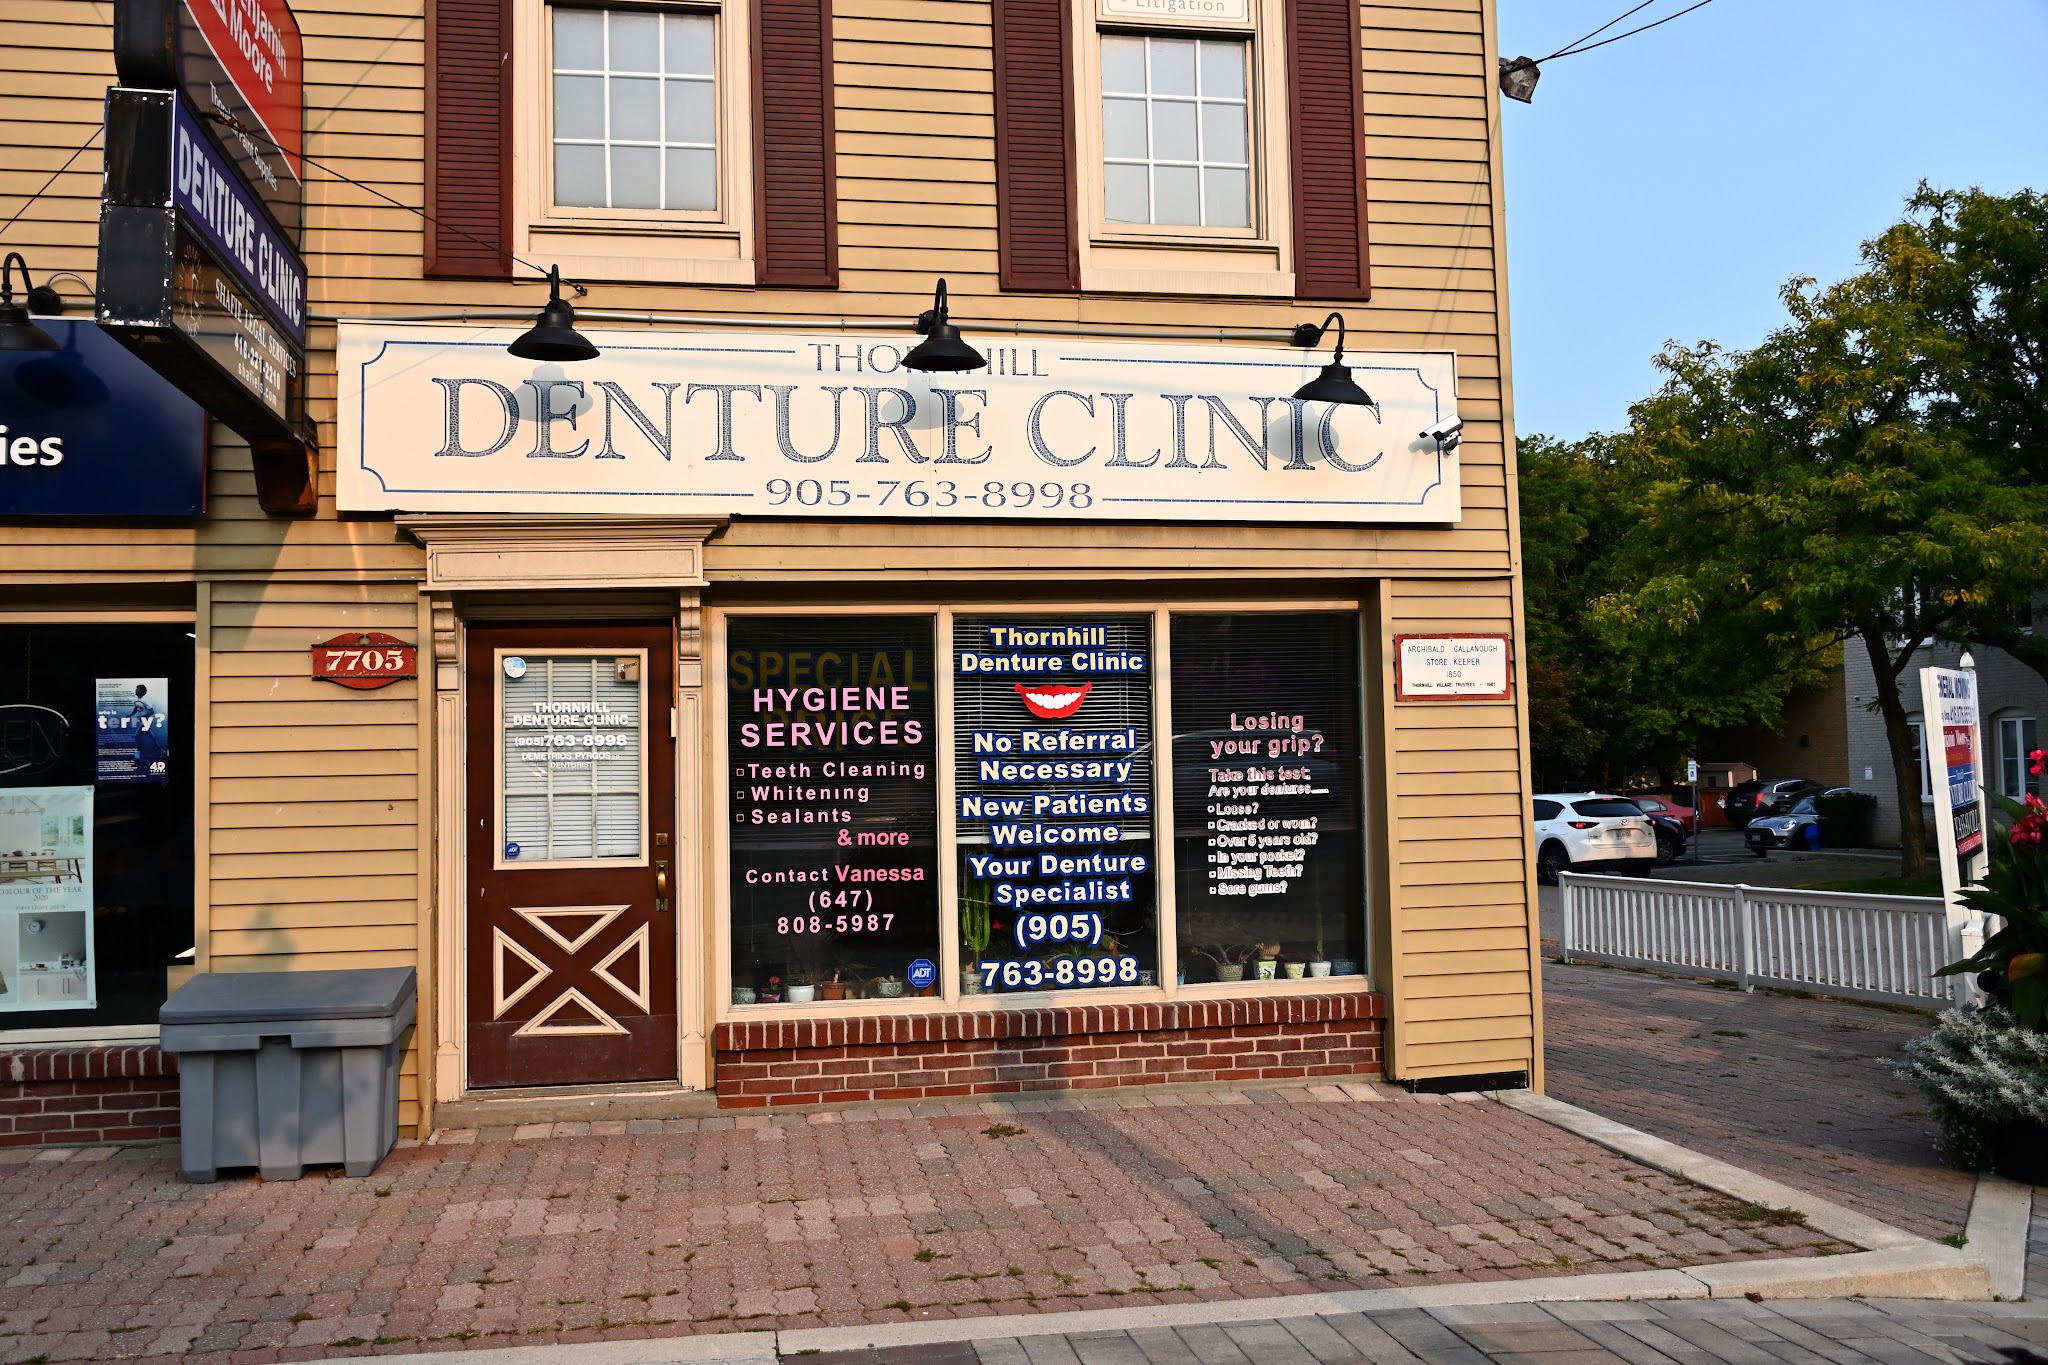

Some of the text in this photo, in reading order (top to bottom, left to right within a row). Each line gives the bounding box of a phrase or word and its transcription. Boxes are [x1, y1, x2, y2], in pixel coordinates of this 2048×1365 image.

[1136, 0, 1225, 13] Litigation
[229, 0, 273, 94] Moore
[254, 146, 277, 191] Supplies
[178, 124, 301, 328] DENTURE CLINIC
[215, 278, 297, 379] SHAFIE LEGAL SERVICES
[238, 362, 277, 406] shafiels.com
[431, 377, 1384, 473] DENTURE CLINIC
[766, 478, 1094, 509] 905-763-8998
[989, 626, 1105, 646] Thornhill
[1407, 645, 1498, 653] ARCHIBALD GALLANOUGH
[325, 649, 404, 671] 7705
[729, 649, 928, 691] SPECIAL
[961, 651, 1144, 672] Denture Clinic
[1426, 658, 1480, 666] STORE KEEPER
[1446, 670, 1462, 678] 1850
[533, 702, 611, 713] THORNHILL
[753, 686, 910, 713] HYGIENE
[513, 714, 629, 726] DENTURE CLINIC
[1230, 711, 1304, 733] Losing
[740, 720, 923, 748] SERVICES
[974, 729, 1136, 753] No Referral
[521, 752, 572, 760] DEMETRIOS
[575, 751, 611, 760] PYRGOS
[1210, 734, 1324, 759] your grip?
[748, 761, 926, 779] Teeth Cleaning
[980, 760, 1132, 783] Necessary
[1208, 768, 1244, 783] Take
[1247, 766, 1275, 782] this
[751, 785, 870, 803] Whitening
[1208, 785, 1231, 797] Are
[1233, 785, 1260, 798] your
[962, 793, 1148, 817] New Patients
[1216, 801, 1260, 816] Loose?
[751, 808, 852, 824] Sealants
[1216, 816, 1318, 831] Cracked or worn?
[837, 828, 910, 846] & more
[992, 824, 1119, 845] Welcome
[1216, 831, 1319, 849] Over 5 years old?
[969, 853, 1146, 877] Your Denture
[1216, 847, 1306, 865] In your pocket?
[746, 864, 925, 884] Contact Vanessa
[1216, 863, 1304, 881] Missing Teeth?
[32, 887, 44, 895] OF
[45, 886, 62, 894] THE
[33, 894, 49, 902] 2020
[996, 880, 1131, 908] Specialist
[1217, 879, 1288, 897] Sore gums?
[808, 889, 873, 913] (647)
[776, 913, 895, 935] 808-5987
[1016, 913, 1102, 948] (905)
[912, 967, 932, 978] ADT
[980, 957, 1139, 987] 763-8998
